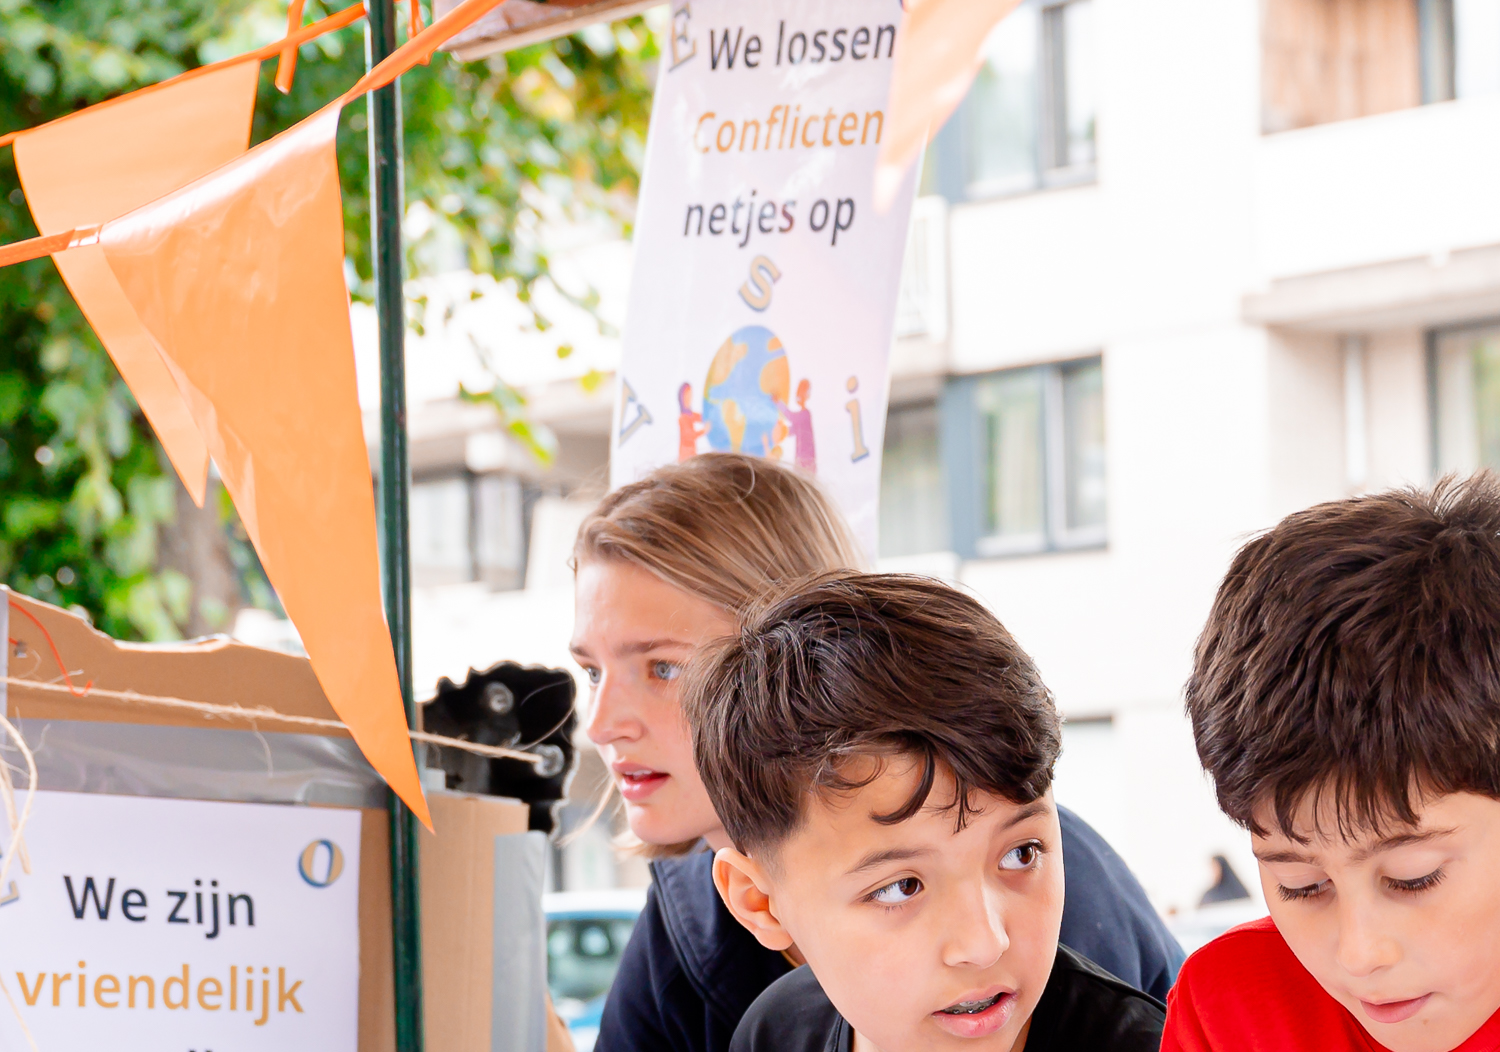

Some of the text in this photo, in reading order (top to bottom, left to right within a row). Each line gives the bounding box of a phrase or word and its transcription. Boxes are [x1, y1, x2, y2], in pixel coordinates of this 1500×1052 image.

[709, 20, 897, 70] We lossen
[694, 104, 885, 153] Conflicten
[683, 189, 856, 248] netjes op
[64, 875, 147, 922] We
[166, 879, 256, 939] zijn
[16, 960, 305, 1027] vriendelijk
